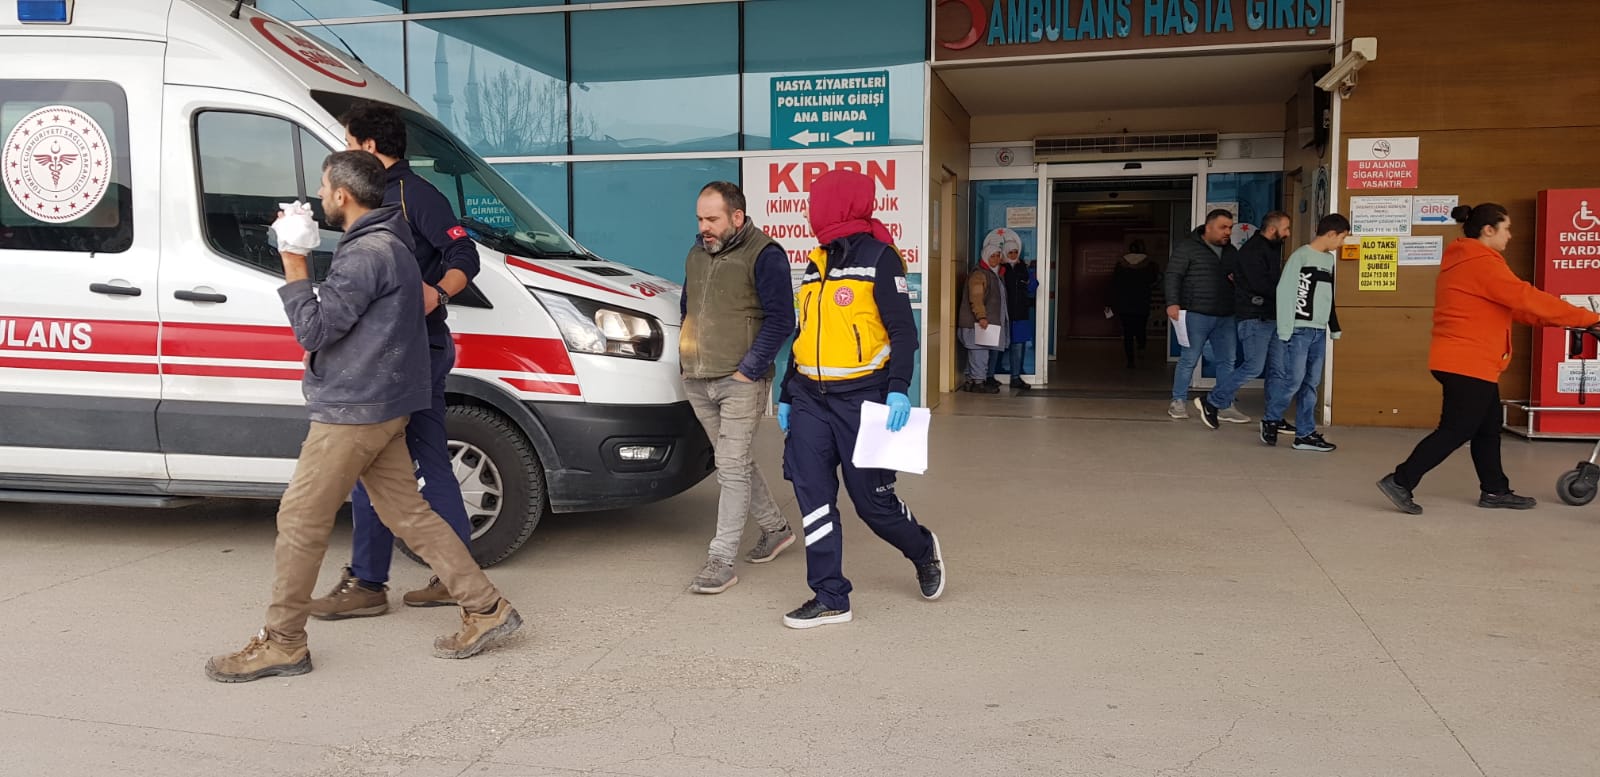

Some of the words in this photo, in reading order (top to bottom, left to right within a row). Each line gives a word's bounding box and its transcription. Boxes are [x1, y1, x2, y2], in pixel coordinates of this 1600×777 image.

[987, 0, 1132, 46] AMBULANS
[775, 79, 812, 92] HASTA
[815, 75, 886, 90] ZİYARETLERİ
[777, 92, 845, 107] POLİKLİNİK
[847, 90, 884, 107] GİRİŞİ
[793, 111, 819, 123] ANA
[821, 108, 867, 122] BİNADA
[1359, 161, 1371, 169] BU
[1352, 170, 1384, 179] SİGARA
[1385, 169, 1412, 180] İÇMEK
[1361, 180, 1402, 188] YASAKTIR
[766, 196, 810, 216] (KİMYA
[1420, 203, 1450, 215] GİRİŞ
[1362, 241, 1376, 249] ALO
[1364, 253, 1394, 261] HASTANE
[1295, 272, 1313, 317] POWER
